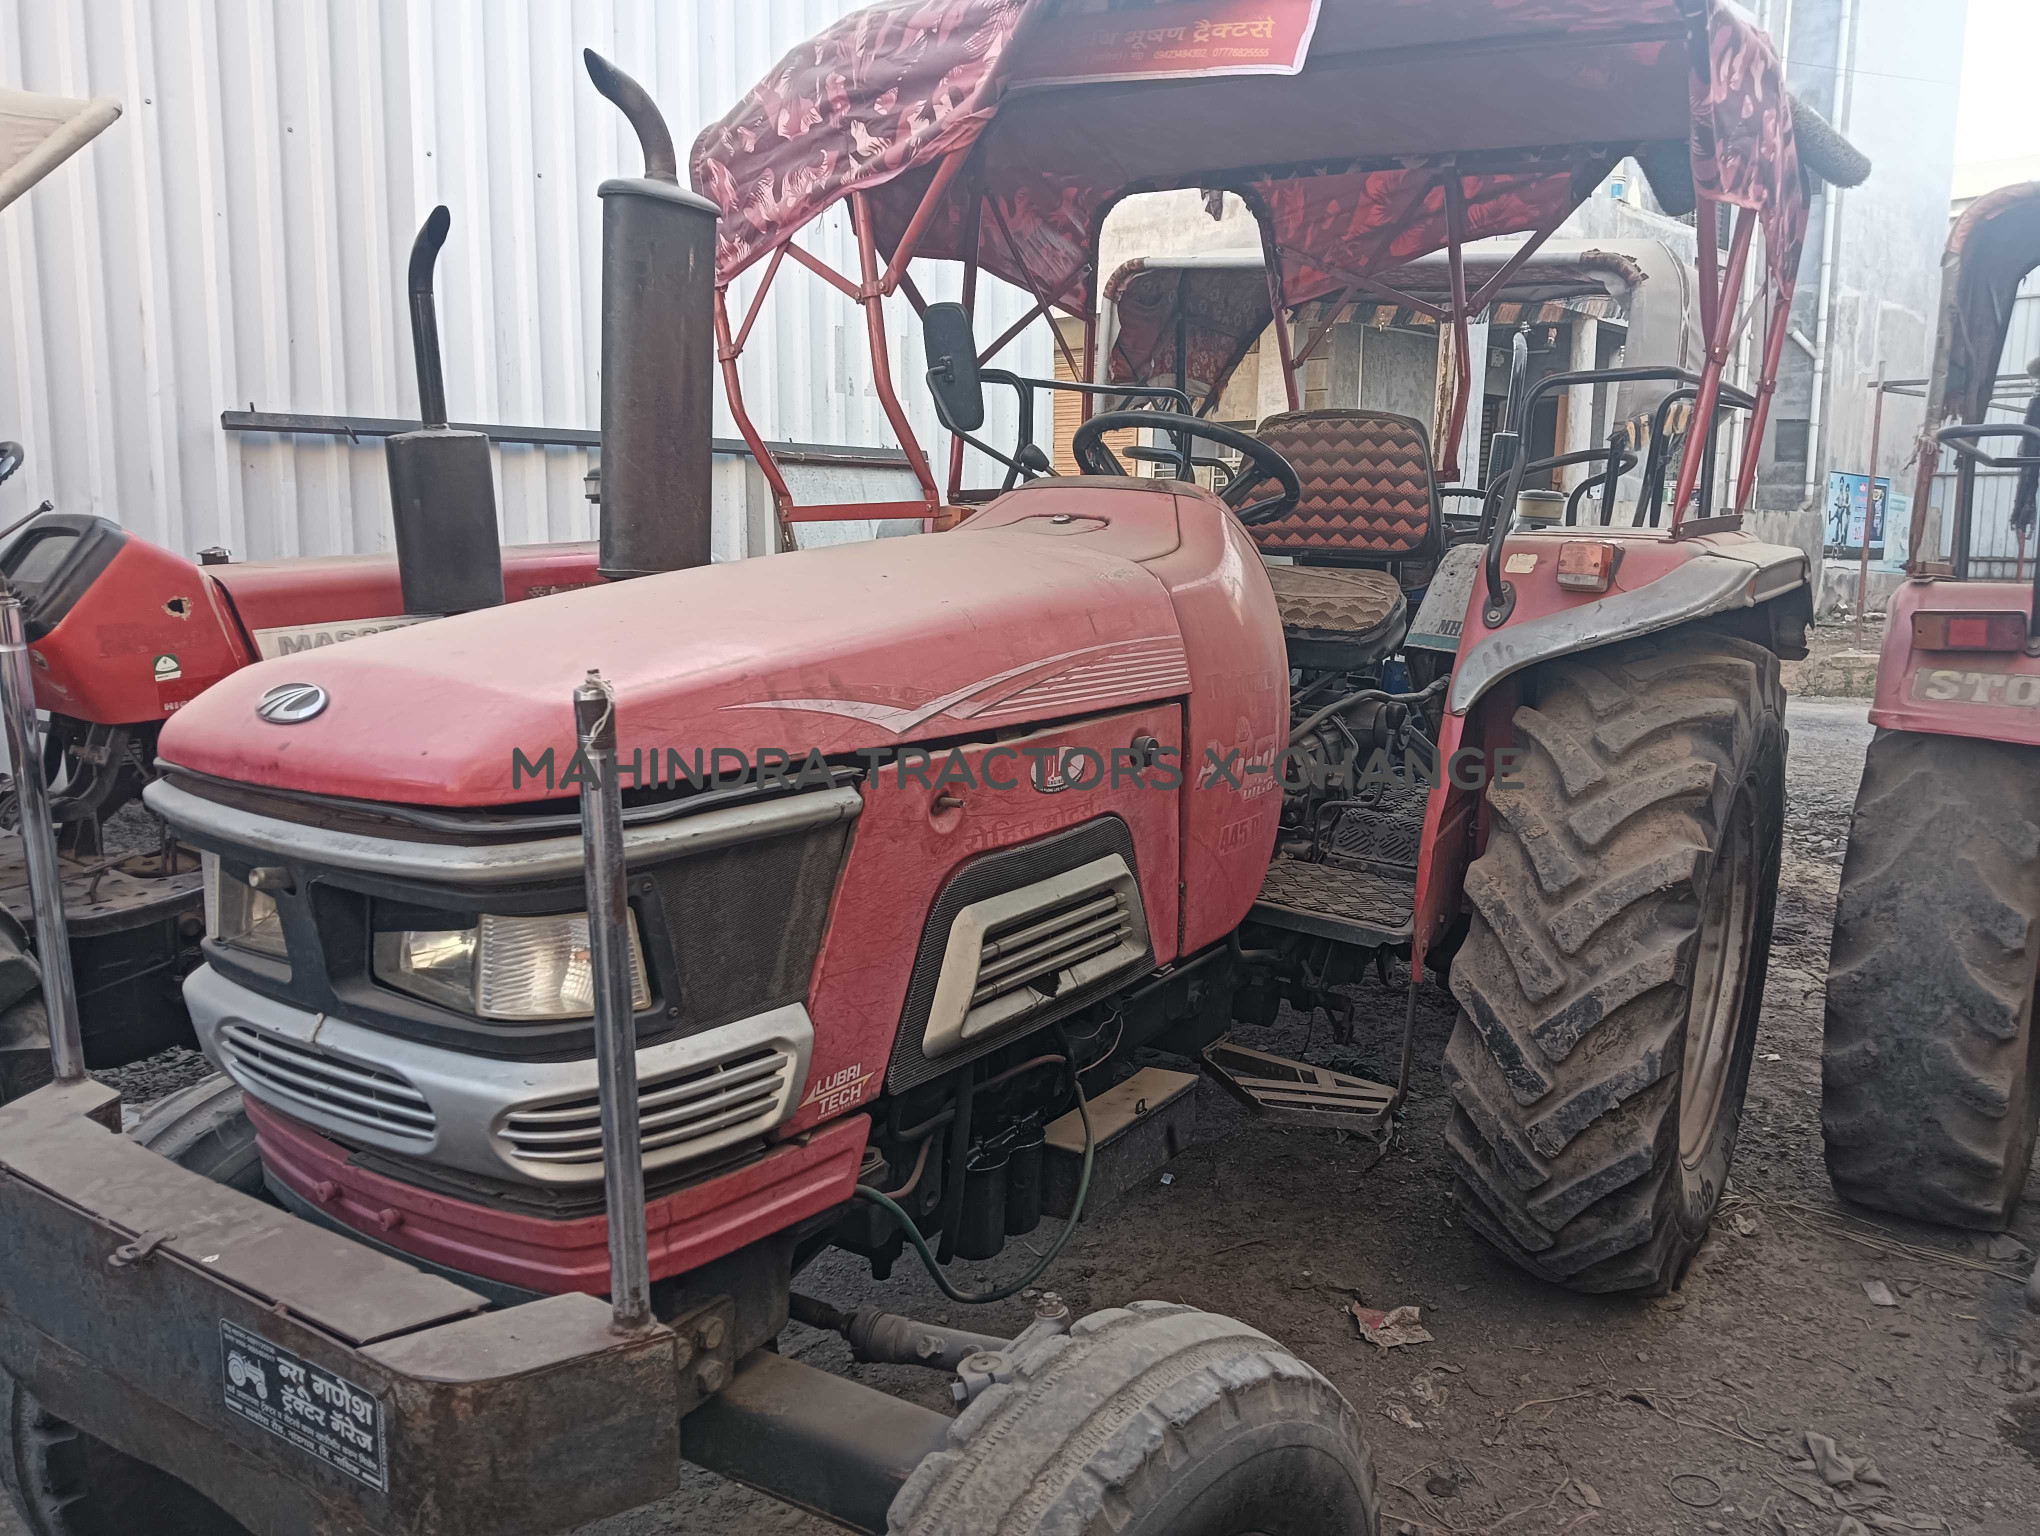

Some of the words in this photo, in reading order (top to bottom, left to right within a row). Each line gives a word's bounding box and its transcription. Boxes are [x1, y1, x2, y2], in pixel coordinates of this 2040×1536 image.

[815, 1062, 861, 1095] LUBRI
[819, 1081, 861, 1114] TECH
[311, 1374, 373, 1426] गणेश
[330, 1410, 373, 1452] गॅरेज
